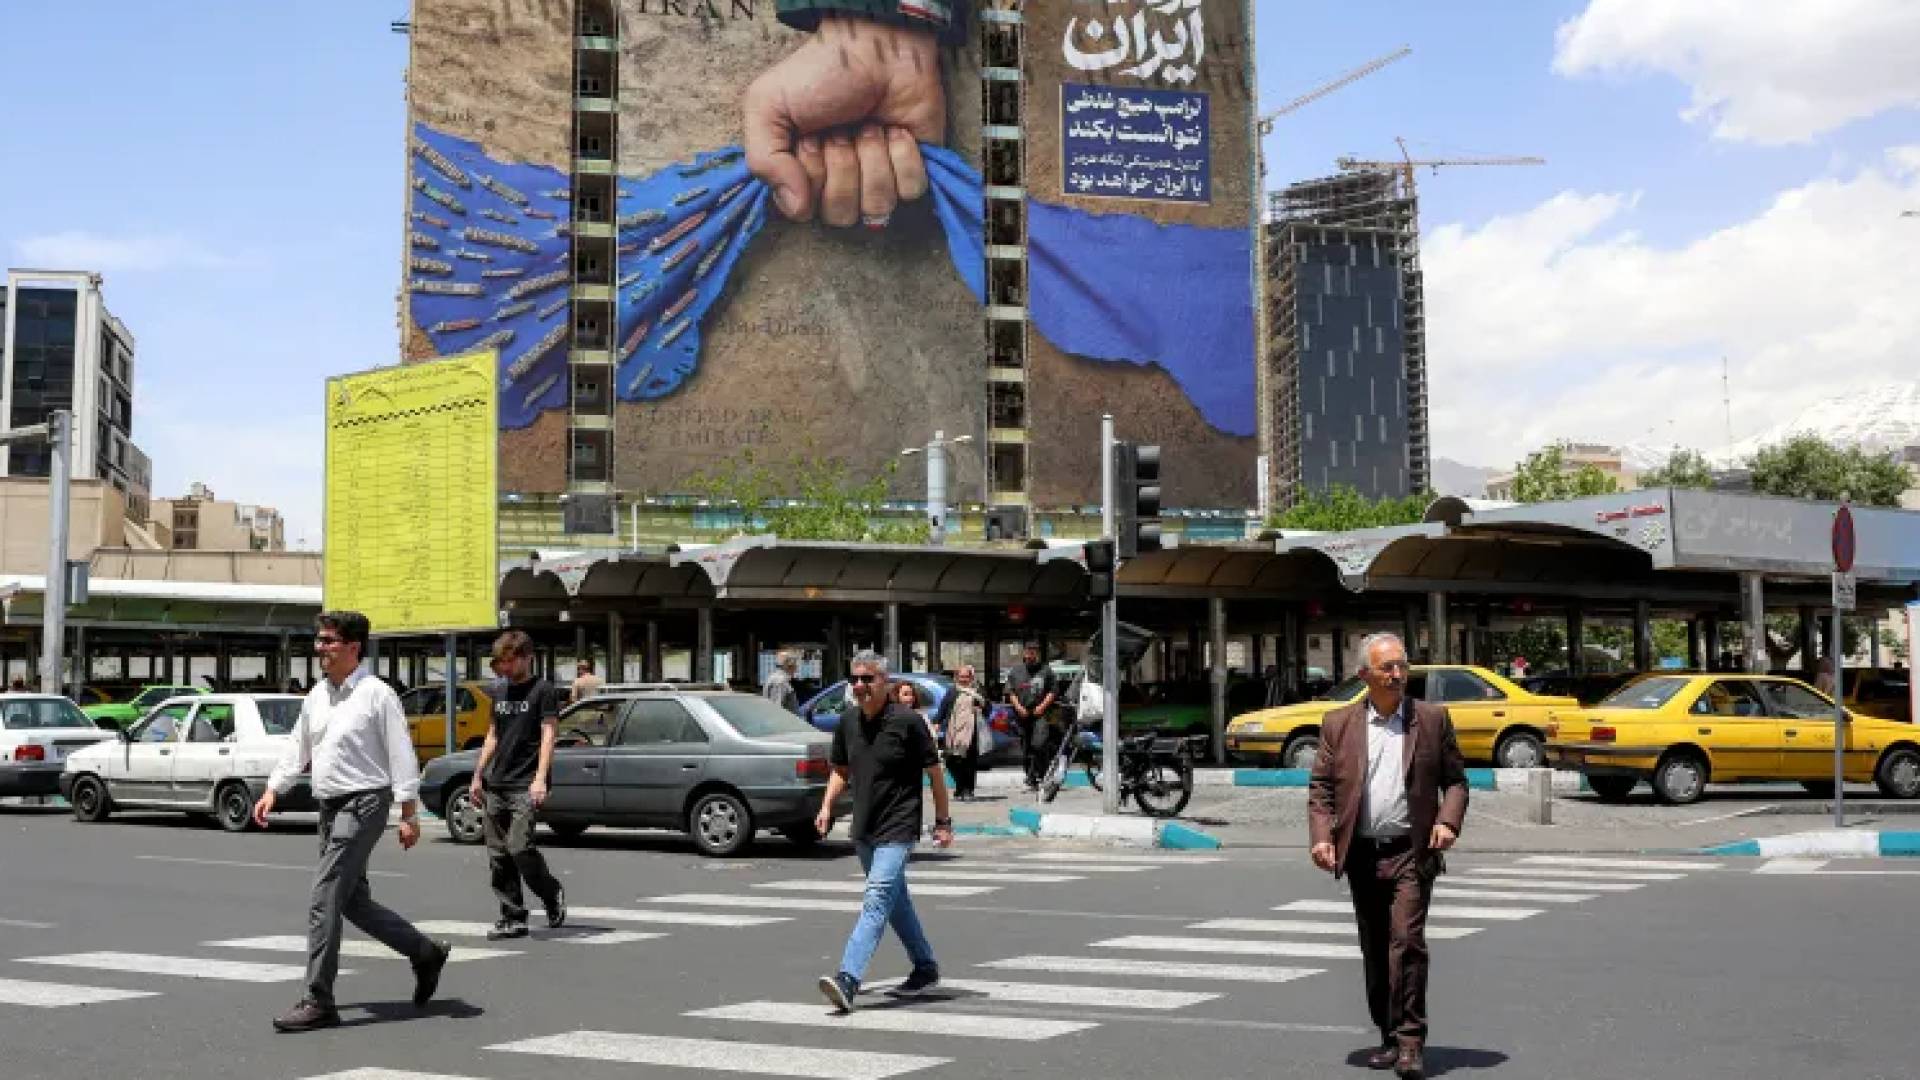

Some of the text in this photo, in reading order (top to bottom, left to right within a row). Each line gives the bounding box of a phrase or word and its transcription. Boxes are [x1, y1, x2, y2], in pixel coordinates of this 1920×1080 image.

[638, 0, 754, 21] IRAN
[1063, 7, 1205, 85] ایران
[1066, 89, 1202, 122] ترامپ هیچ غلطی
[1069, 118, 1202, 151] نتوانست بکند
[1069, 171, 1202, 197] با ایران خواهد بود
